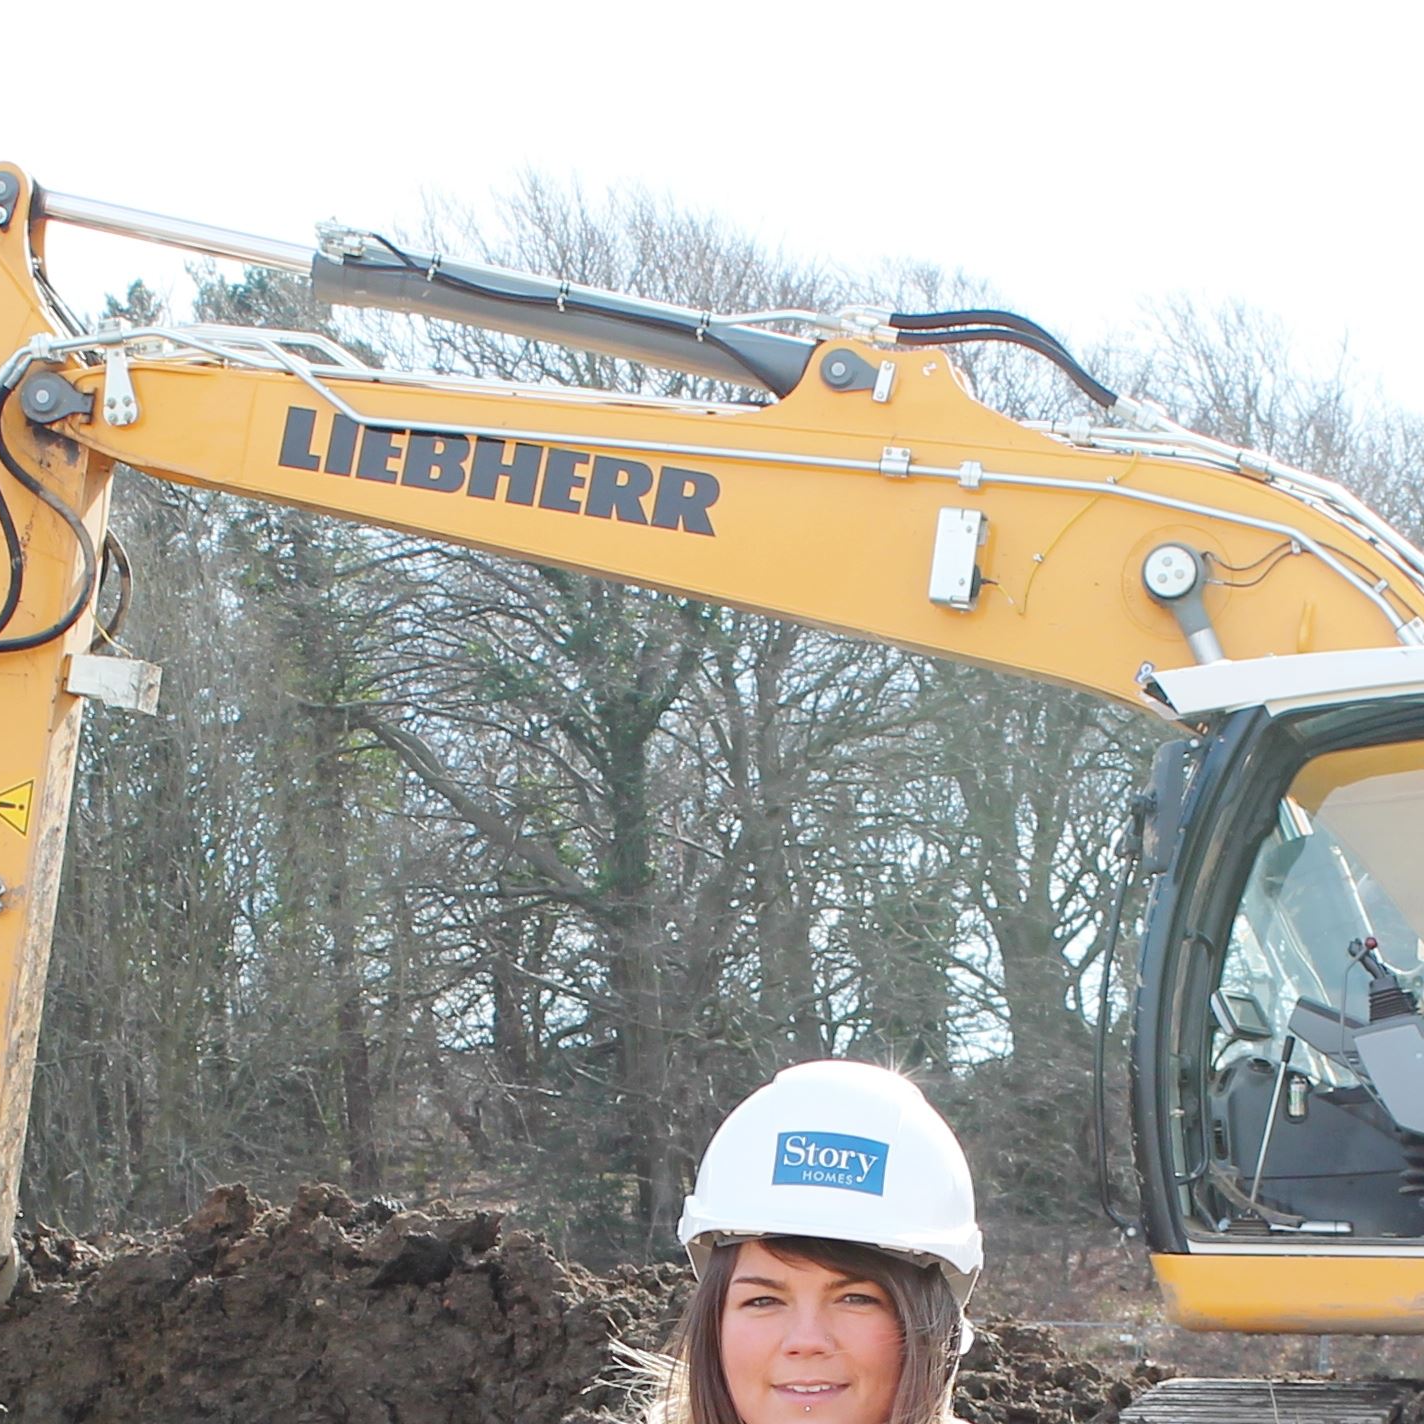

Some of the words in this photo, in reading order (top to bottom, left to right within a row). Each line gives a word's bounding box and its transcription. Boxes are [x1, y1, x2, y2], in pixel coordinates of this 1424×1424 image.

[278, 406, 721, 537] LIEBHERR
[783, 1135, 878, 1182] Story
[802, 1170, 853, 1184] HOMES
